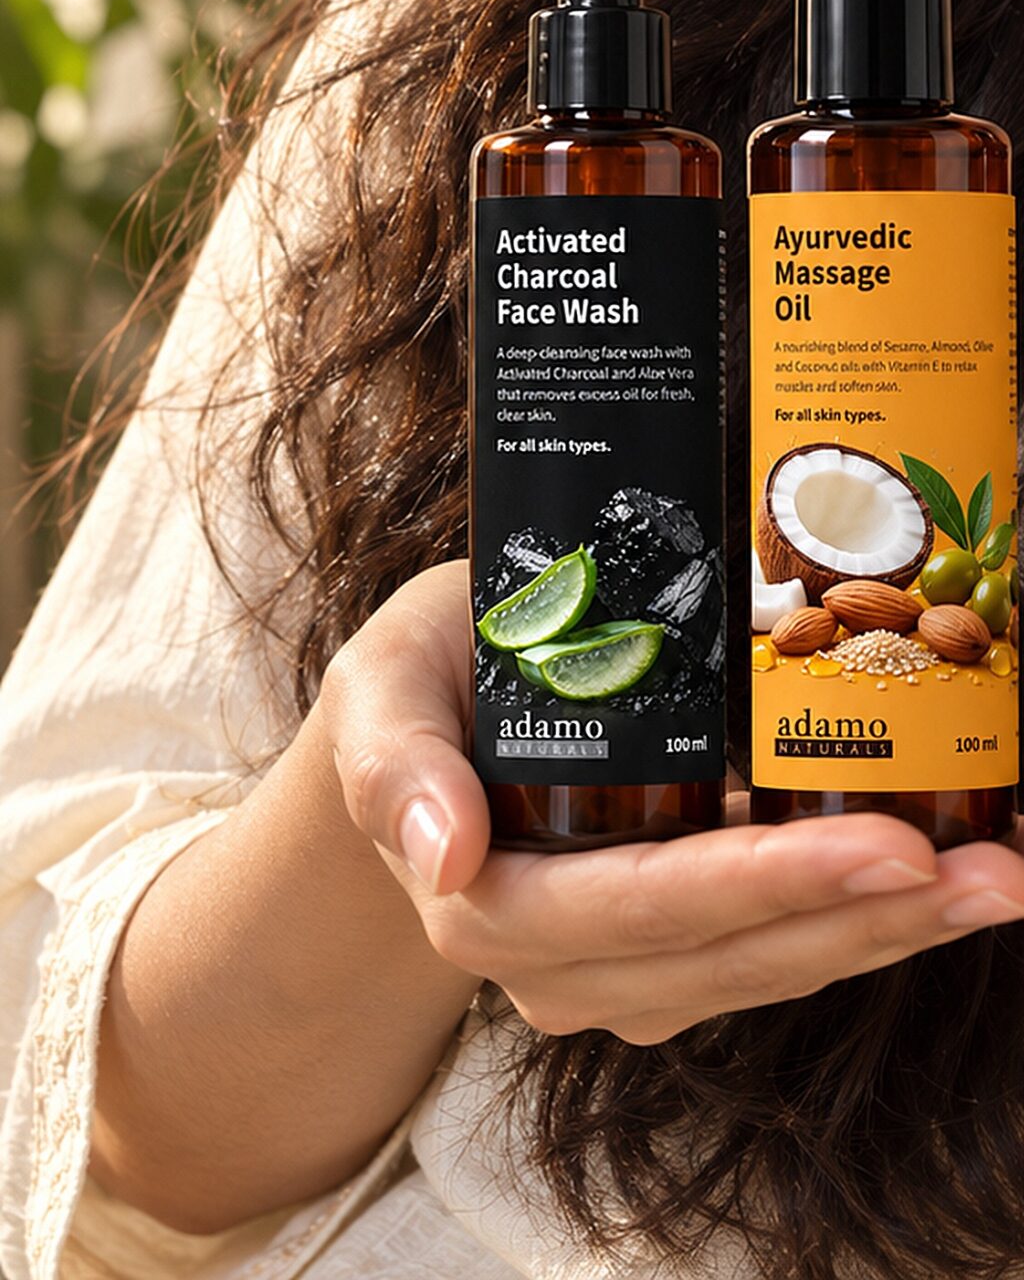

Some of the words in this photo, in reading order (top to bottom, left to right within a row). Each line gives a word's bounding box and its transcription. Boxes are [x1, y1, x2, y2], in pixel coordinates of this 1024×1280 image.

[497, 227, 626, 254] Activated
[774, 223, 912, 255] Ayurvedic
[498, 262, 617, 289] Charcoal
[775, 261, 890, 291] Massage
[498, 299, 556, 324] Face
[563, 297, 639, 324] Wash
[775, 294, 811, 321] Oil
[497, 347, 505, 359] A
[601, 346, 627, 359] face
[629, 346, 663, 359] wash
[665, 346, 691, 359] with
[774, 342, 781, 353] A
[783, 341, 836, 355] nourishing
[837, 341, 868, 353] blend
[870, 341, 882, 353] of
[496, 367, 551, 380] Activated
[553, 367, 609, 380] Charcoal
[612, 367, 636, 379] and
[638, 366, 666, 379] Aloe
[667, 367, 694, 379] Vera
[774, 361, 793, 373] and
[795, 361, 838, 373] Coconut
[862, 360, 886, 373] with
[888, 361, 930, 373] Vitamin
[932, 360, 940, 373] E
[941, 361, 952, 372] to
[954, 361, 977, 373] relax
[497, 388, 520, 400] that
[523, 389, 576, 401] removes
[578, 390, 620, 401] excess
[622, 388, 639, 400] oil
[641, 387, 658, 400] for
[816, 380, 837, 393] and
[839, 380, 873, 393] soften
[497, 408, 525, 421] clear
[775, 408, 794, 421] For
[796, 408, 811, 421] all
[814, 407, 841, 421] skin
[844, 409, 886, 424] types.
[497, 439, 518, 452] For
[519, 438, 536, 452] all
[538, 438, 566, 452] skin
[568, 440, 611, 455] types.
[499, 711, 604, 739] adamo
[778, 708, 888, 738] adamo
[500, 742, 605, 756] NATURALS
[665, 738, 691, 753] 100
[692, 735, 708, 752] ml
[778, 742, 887, 756] NATURALS
[955, 737, 980, 753] 100
[982, 735, 998, 752] ml
